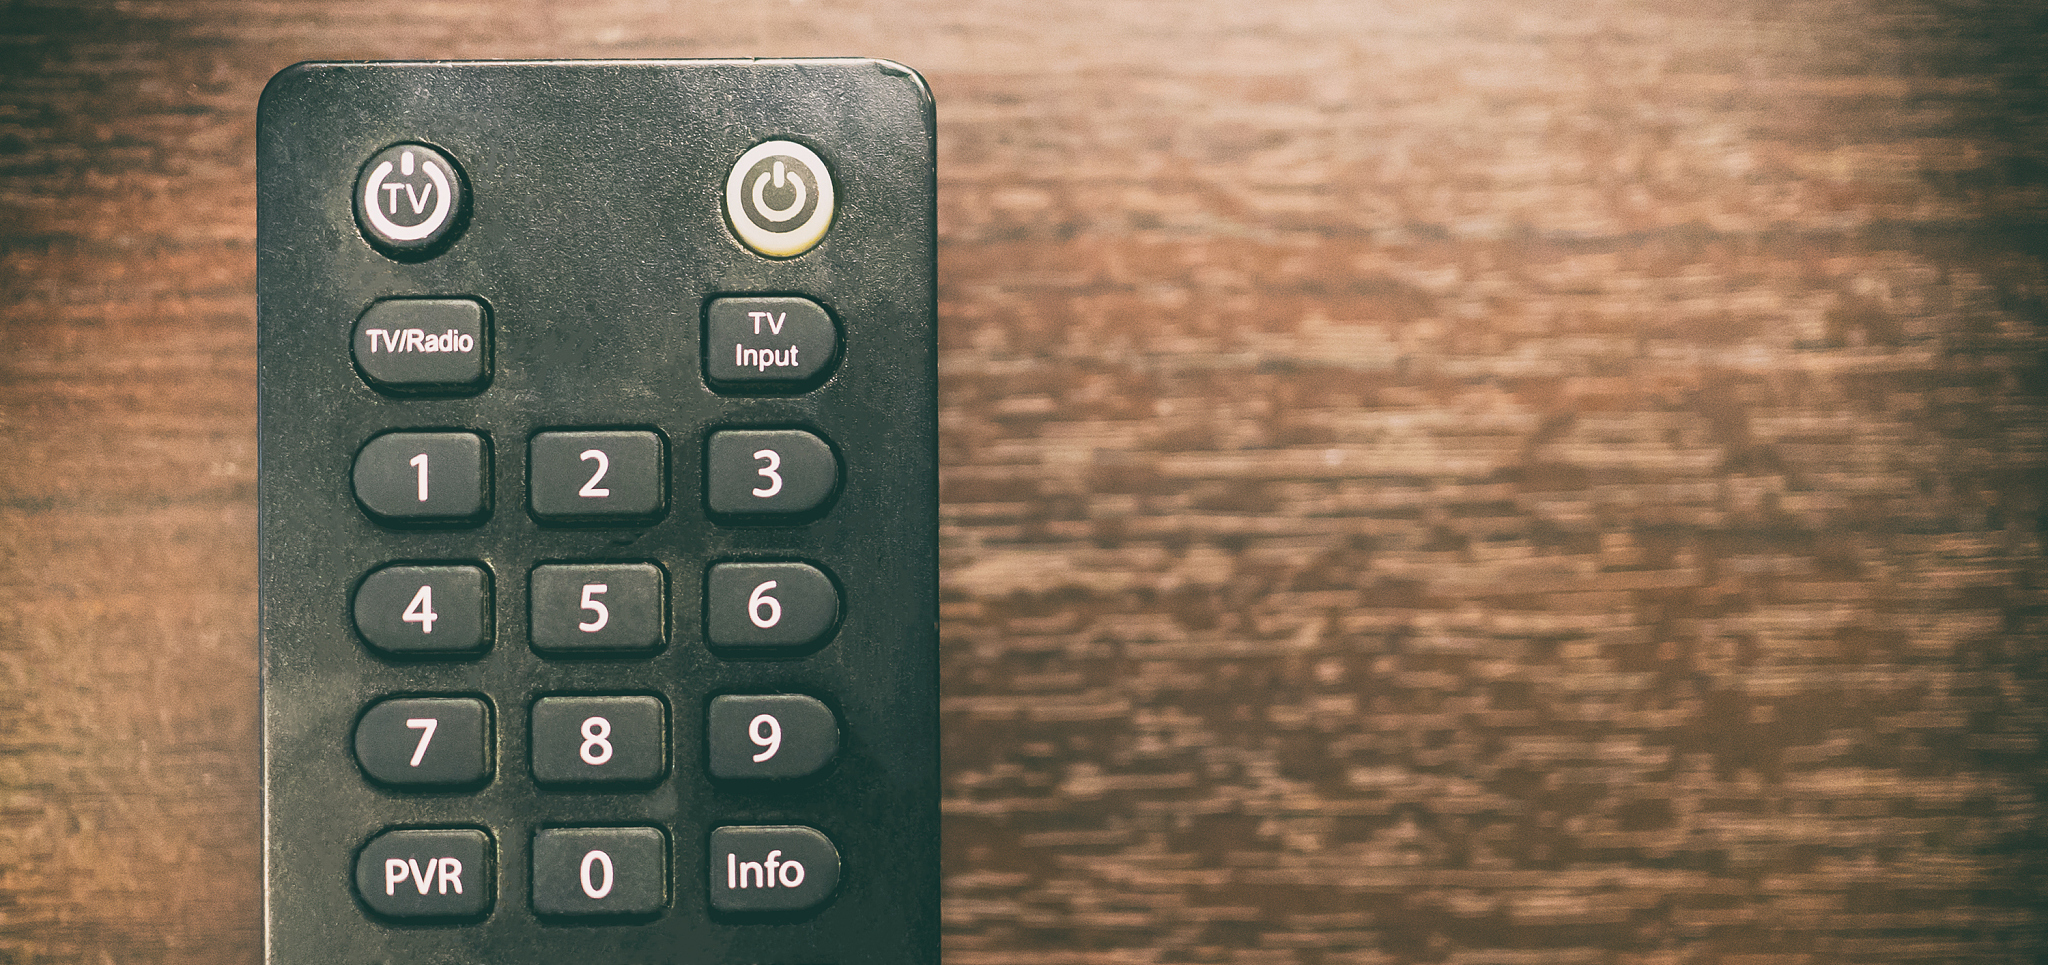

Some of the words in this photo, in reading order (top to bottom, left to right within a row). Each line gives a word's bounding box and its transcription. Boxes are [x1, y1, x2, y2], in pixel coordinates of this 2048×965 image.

[382, 182, 433, 215] TV
[365, 328, 474, 354] TV/Radio
[747, 311, 787, 336] TV
[735, 343, 799, 373] Input
[409, 453, 429, 502] 1
[578, 449, 610, 498] 2
[752, 449, 783, 498] 3
[401, 585, 438, 634] 4
[578, 583, 609, 633] 5
[747, 580, 782, 629] 6
[405, 718, 438, 767] 7
[579, 716, 613, 766] 8
[748, 713, 782, 763] 9
[384, 857, 463, 896] PVR
[579, 849, 614, 899] 0
[727, 849, 805, 889] Info
